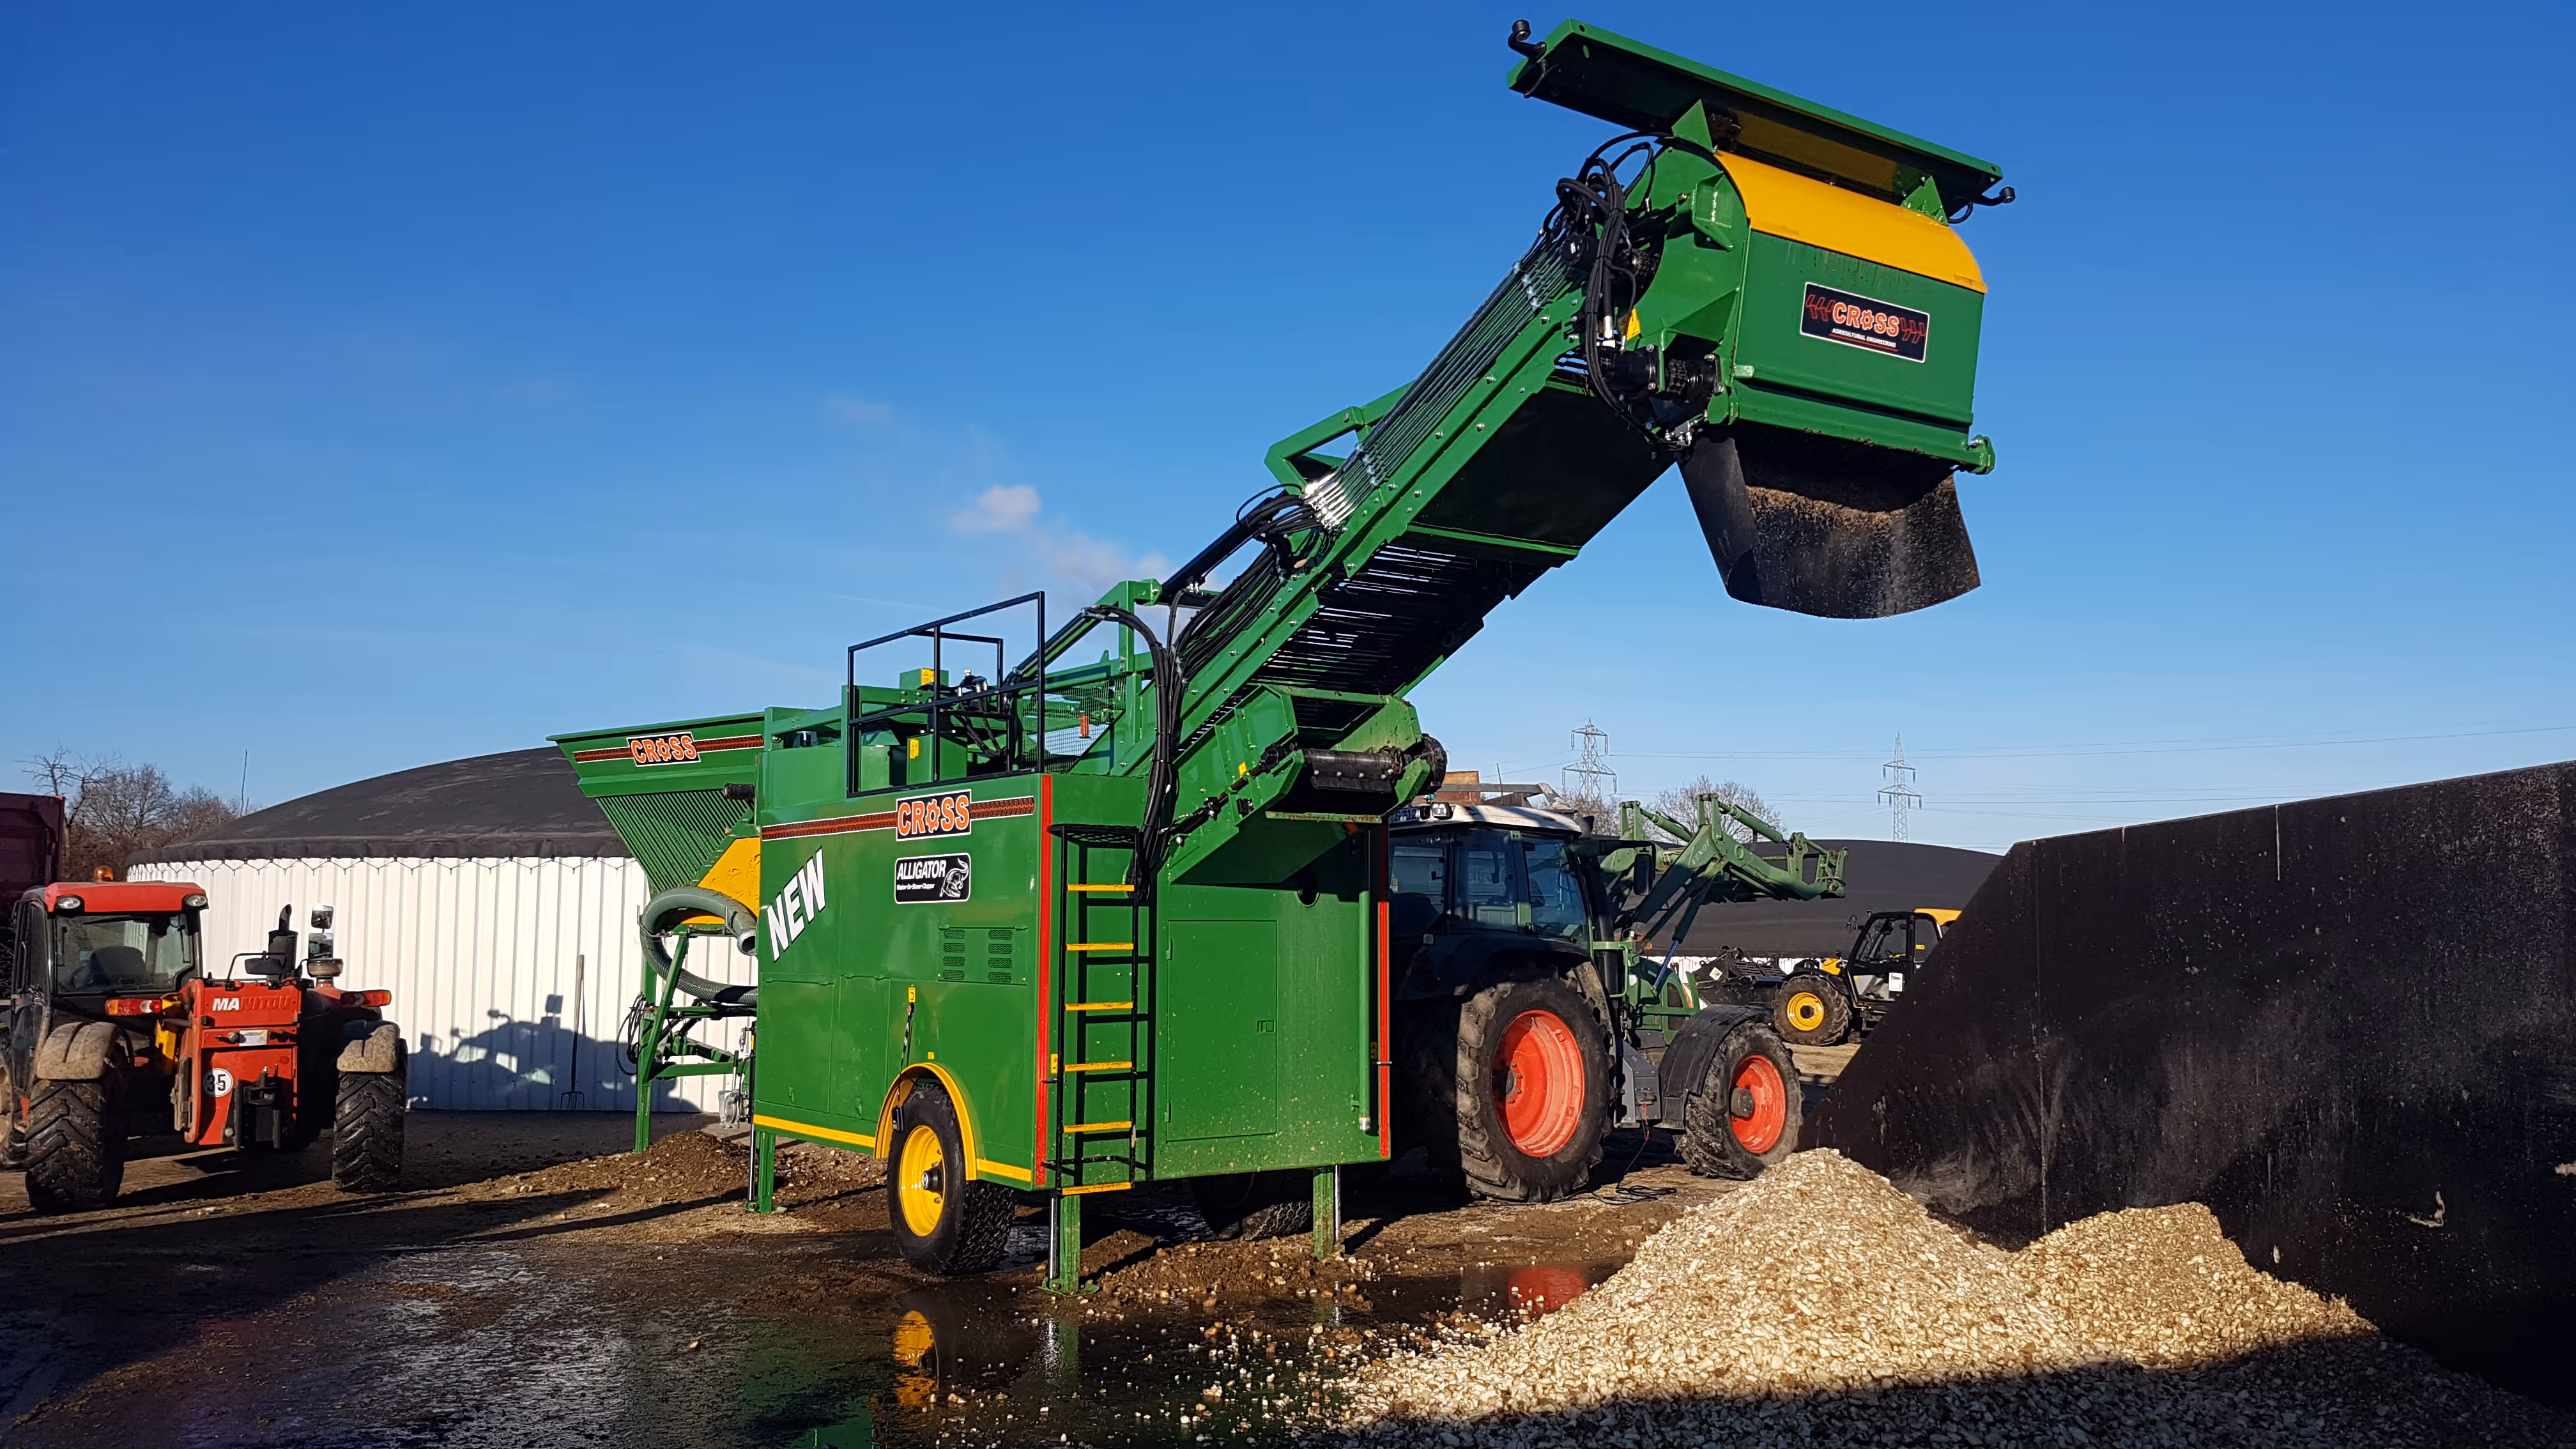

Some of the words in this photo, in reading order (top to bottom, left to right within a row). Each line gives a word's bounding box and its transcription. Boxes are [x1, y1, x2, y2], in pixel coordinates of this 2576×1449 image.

[1833, 302, 1899, 337] CROSS
[1832, 328, 1866, 341] AGRICULTURAL
[631, 735, 697, 763] CROSS
[898, 795, 970, 836] CROSS
[896, 860, 947, 880] ALLIGATOR
[767, 845, 826, 963] NEW
[206, 1074, 226, 1092] 35
